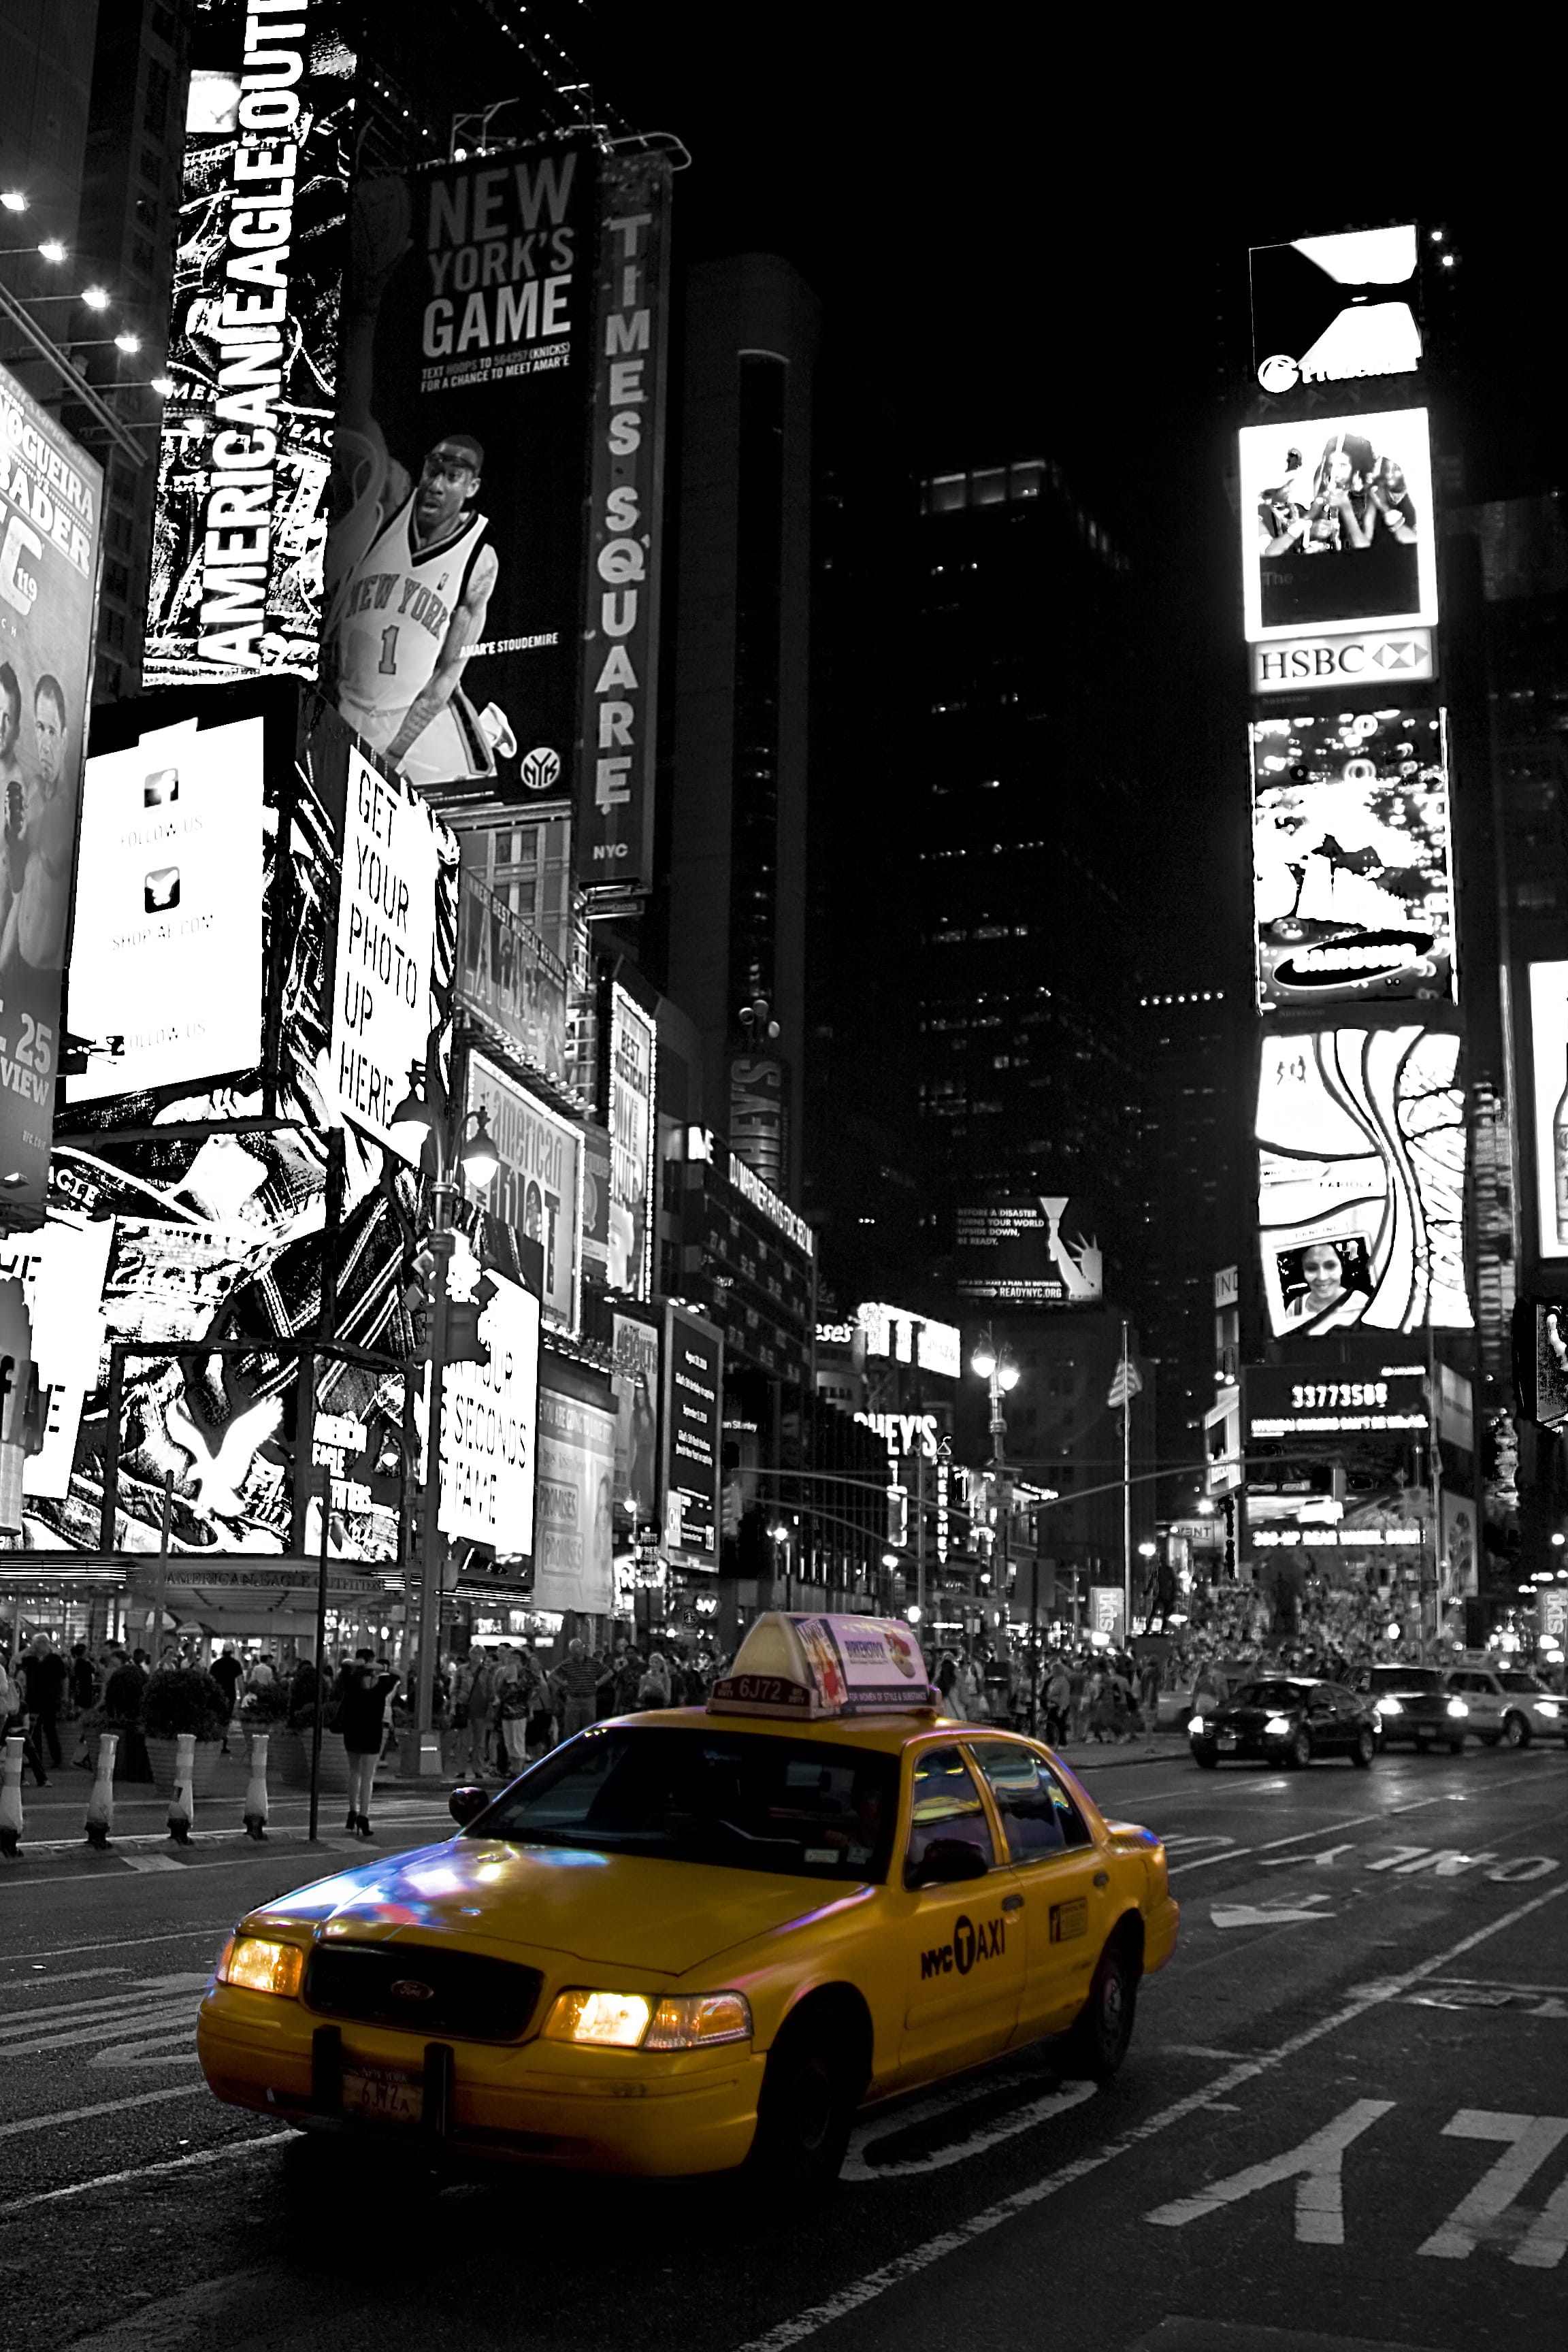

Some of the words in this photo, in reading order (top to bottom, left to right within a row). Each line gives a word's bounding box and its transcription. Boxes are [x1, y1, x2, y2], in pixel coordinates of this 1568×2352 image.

[238, 0, 308, 133] OUT
[428, 152, 577, 250] NEW
[428, 227, 574, 296] YORK'S
[423, 274, 572, 358] GAME
[605, 212, 653, 456] TIMES
[421, 379, 441, 393] FOR
[442, 377, 449, 389] A
[451, 370, 489, 387] CHANCE
[491, 367, 504, 379] TO
[505, 361, 532, 377] MEET
[533, 354, 570, 372] AMAR'E
[422, 365, 445, 380] TEXT
[479, 357, 492, 369] TO
[529, 341, 571, 359] (KNICKS)
[17, 565, 38, 602] 119
[344, 572, 400, 620] NEW
[378, 624, 400, 676] 1
[497, 632, 559, 653] STOUDEMIRE
[594, 485, 647, 806] SQUARE
[1260, 644, 1365, 681] HSBC
[183, 815, 203, 834] US
[358, 769, 397, 848] GET
[592, 843, 628, 860] NYC
[356, 834, 409, 934] YOUR
[348, 902, 418, 1009] PHOTO
[344, 970, 374, 1036] UP
[16, 1012, 52, 1075] 25
[621, 1028, 640, 1065] BEST
[0, 1056, 50, 1107] VIEW
[339, 1040, 395, 1130] HERE
[491, 1090, 563, 1193] american
[989, 1228, 1021, 1238] DOWN,
[990, 1209, 998, 1217] A
[999, 1209, 1038, 1218] DISASTER
[1013, 1219, 1045, 1228] WORLD
[999, 1287, 1062, 1298] READYNYC.ORG
[454, 1393, 526, 1469] SECONDS
[732, 1420, 757, 1433] Stanley
[1099, 1592, 1118, 1631] tkts
[844, 1639, 887, 1659] BIRKENSTOCK
[739, 1677, 782, 1699] 6J72
[849, 1693, 859, 1702] FOR
[860, 1693, 877, 1701] WOMEN
[877, 1693, 884, 1701] OF
[885, 1693, 898, 1701] STYLE
[902, 1692, 927, 1701] SUBSTANCE
[921, 1944, 953, 1980] NYC
